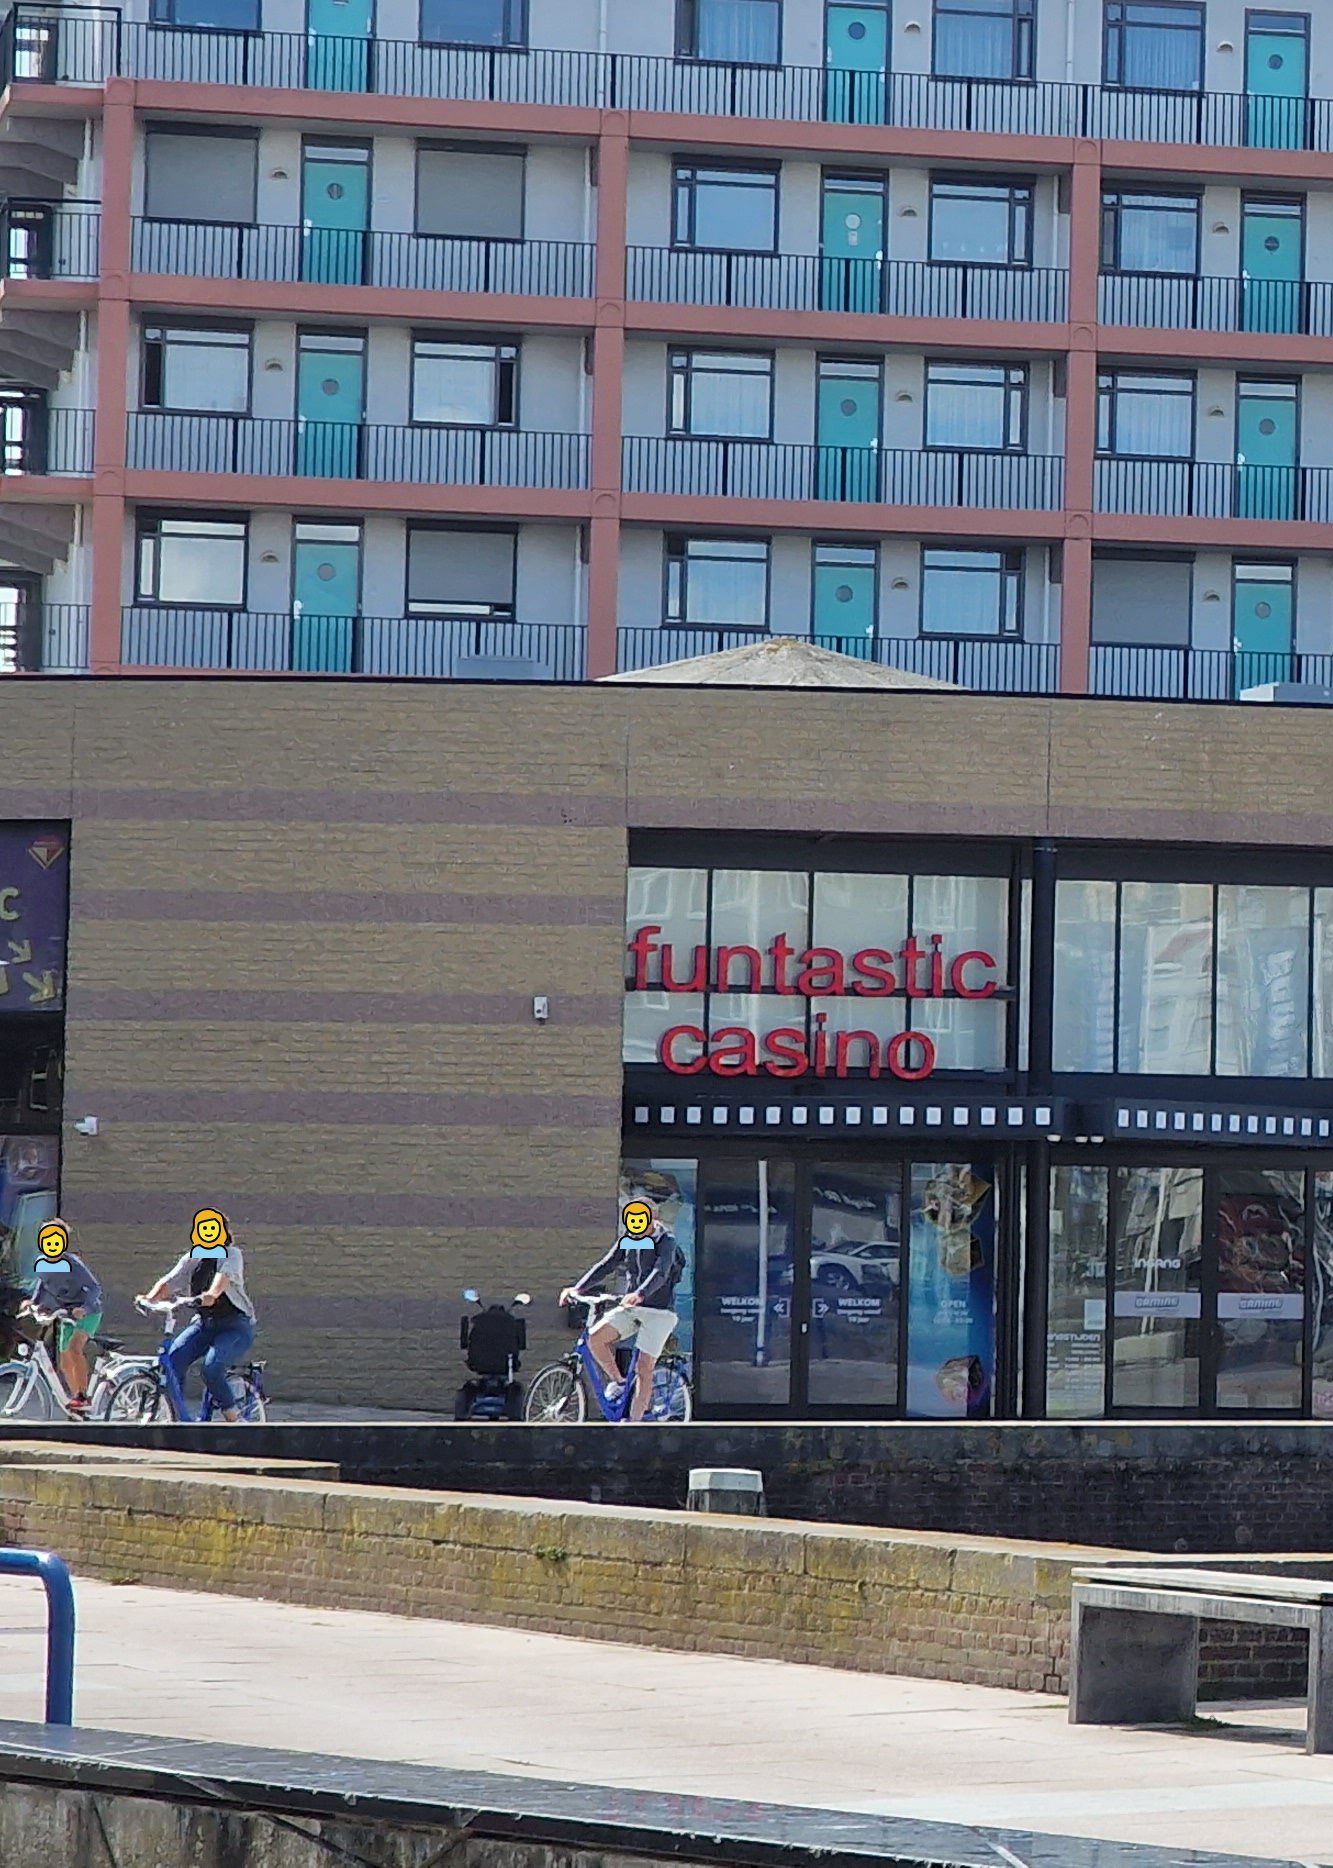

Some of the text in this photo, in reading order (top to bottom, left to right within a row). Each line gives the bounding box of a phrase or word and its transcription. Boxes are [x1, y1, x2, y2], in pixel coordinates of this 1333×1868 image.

[628, 925, 997, 999] funtastic
[660, 1011, 937, 1081] casino
[837, 1298, 880, 1307] WELKOM
